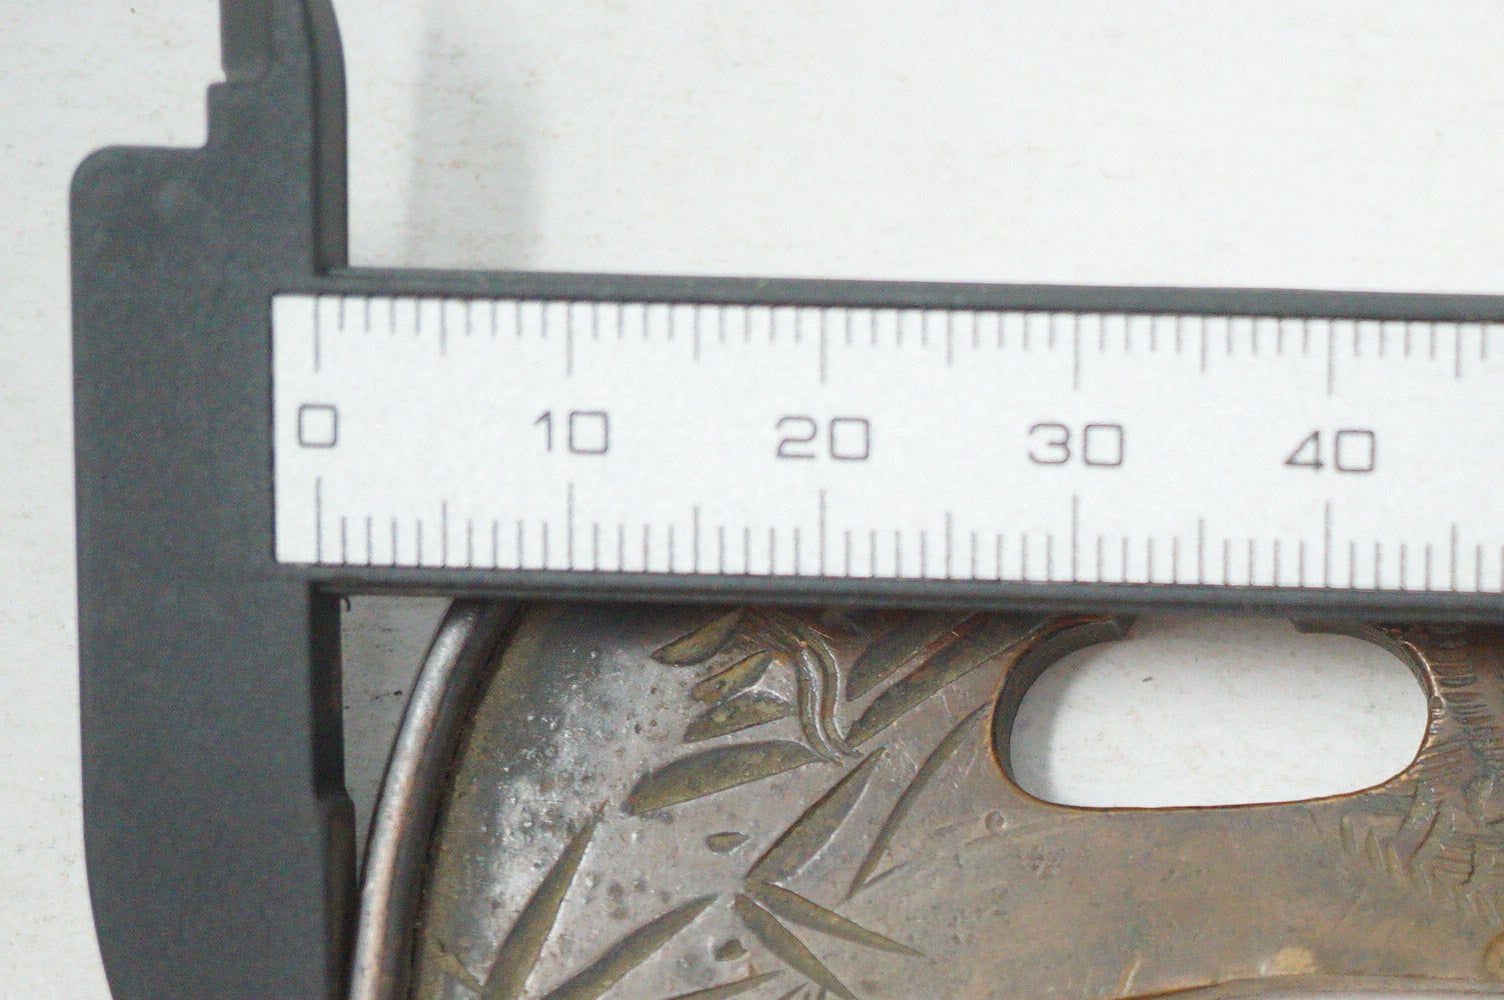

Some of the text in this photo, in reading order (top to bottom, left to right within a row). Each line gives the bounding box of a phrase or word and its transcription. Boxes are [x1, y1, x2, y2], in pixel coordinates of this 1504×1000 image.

[295, 402, 340, 450] 0
[533, 408, 612, 457] 10
[774, 413, 873, 463] 20
[1026, 420, 1127, 470] 30
[1282, 427, 1378, 475] 40
